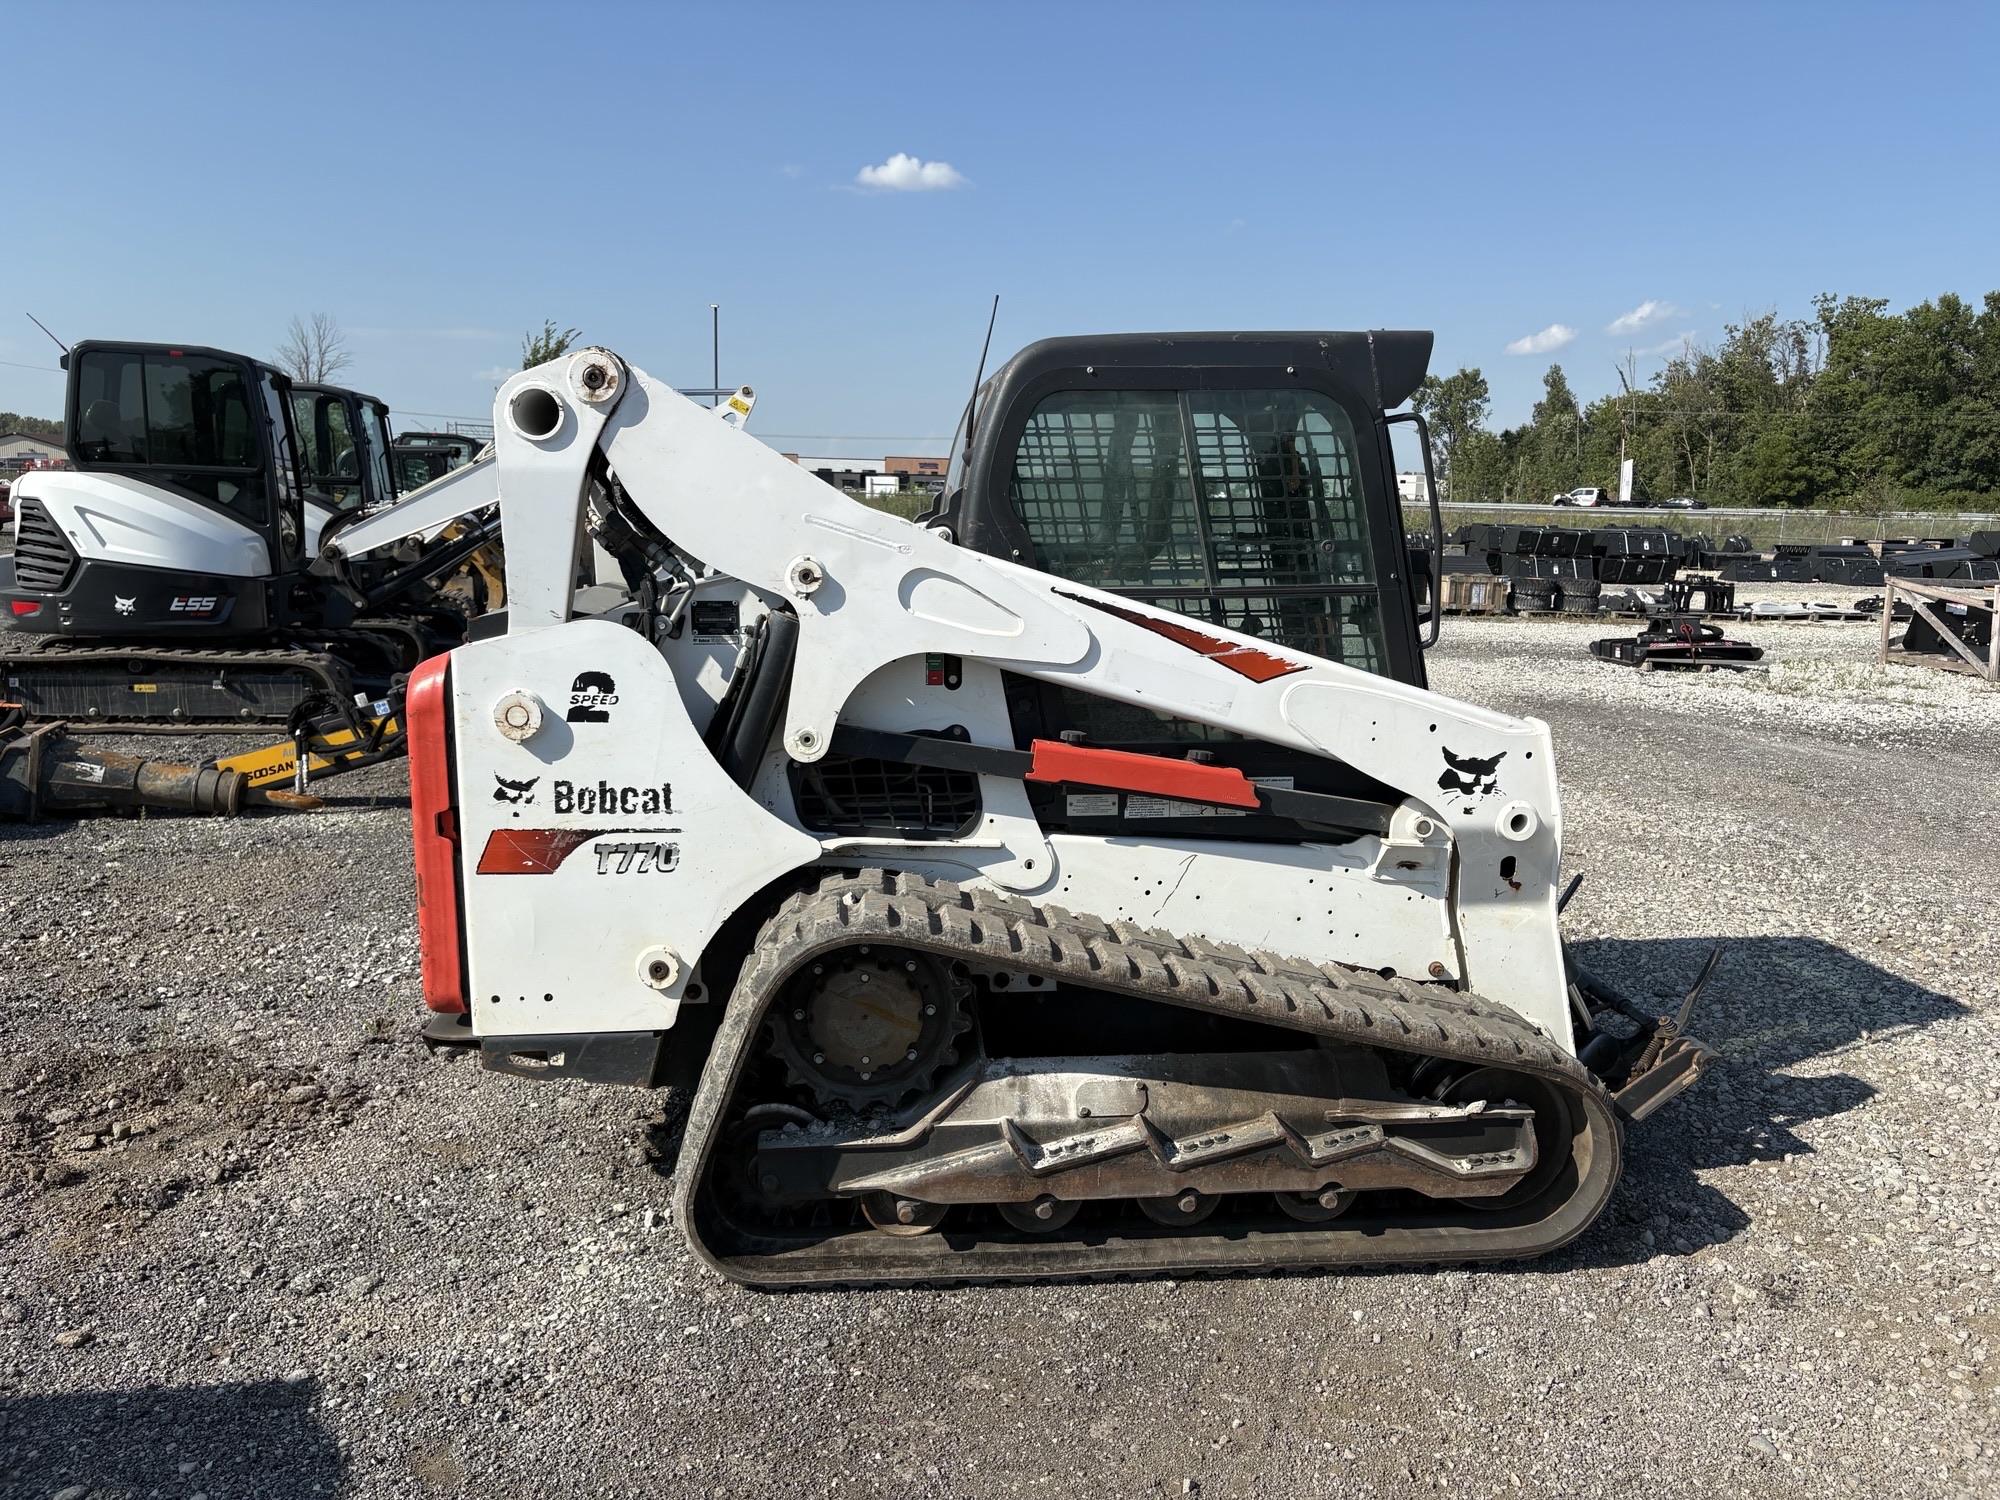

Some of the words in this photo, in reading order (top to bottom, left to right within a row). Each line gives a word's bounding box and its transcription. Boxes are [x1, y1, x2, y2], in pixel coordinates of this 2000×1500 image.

[566, 671, 615, 722] 2
[570, 694, 619, 706] SPEED
[246, 761, 295, 781] SOOSAN
[554, 780, 673, 814] Bobcat
[594, 841, 681, 875] T770
